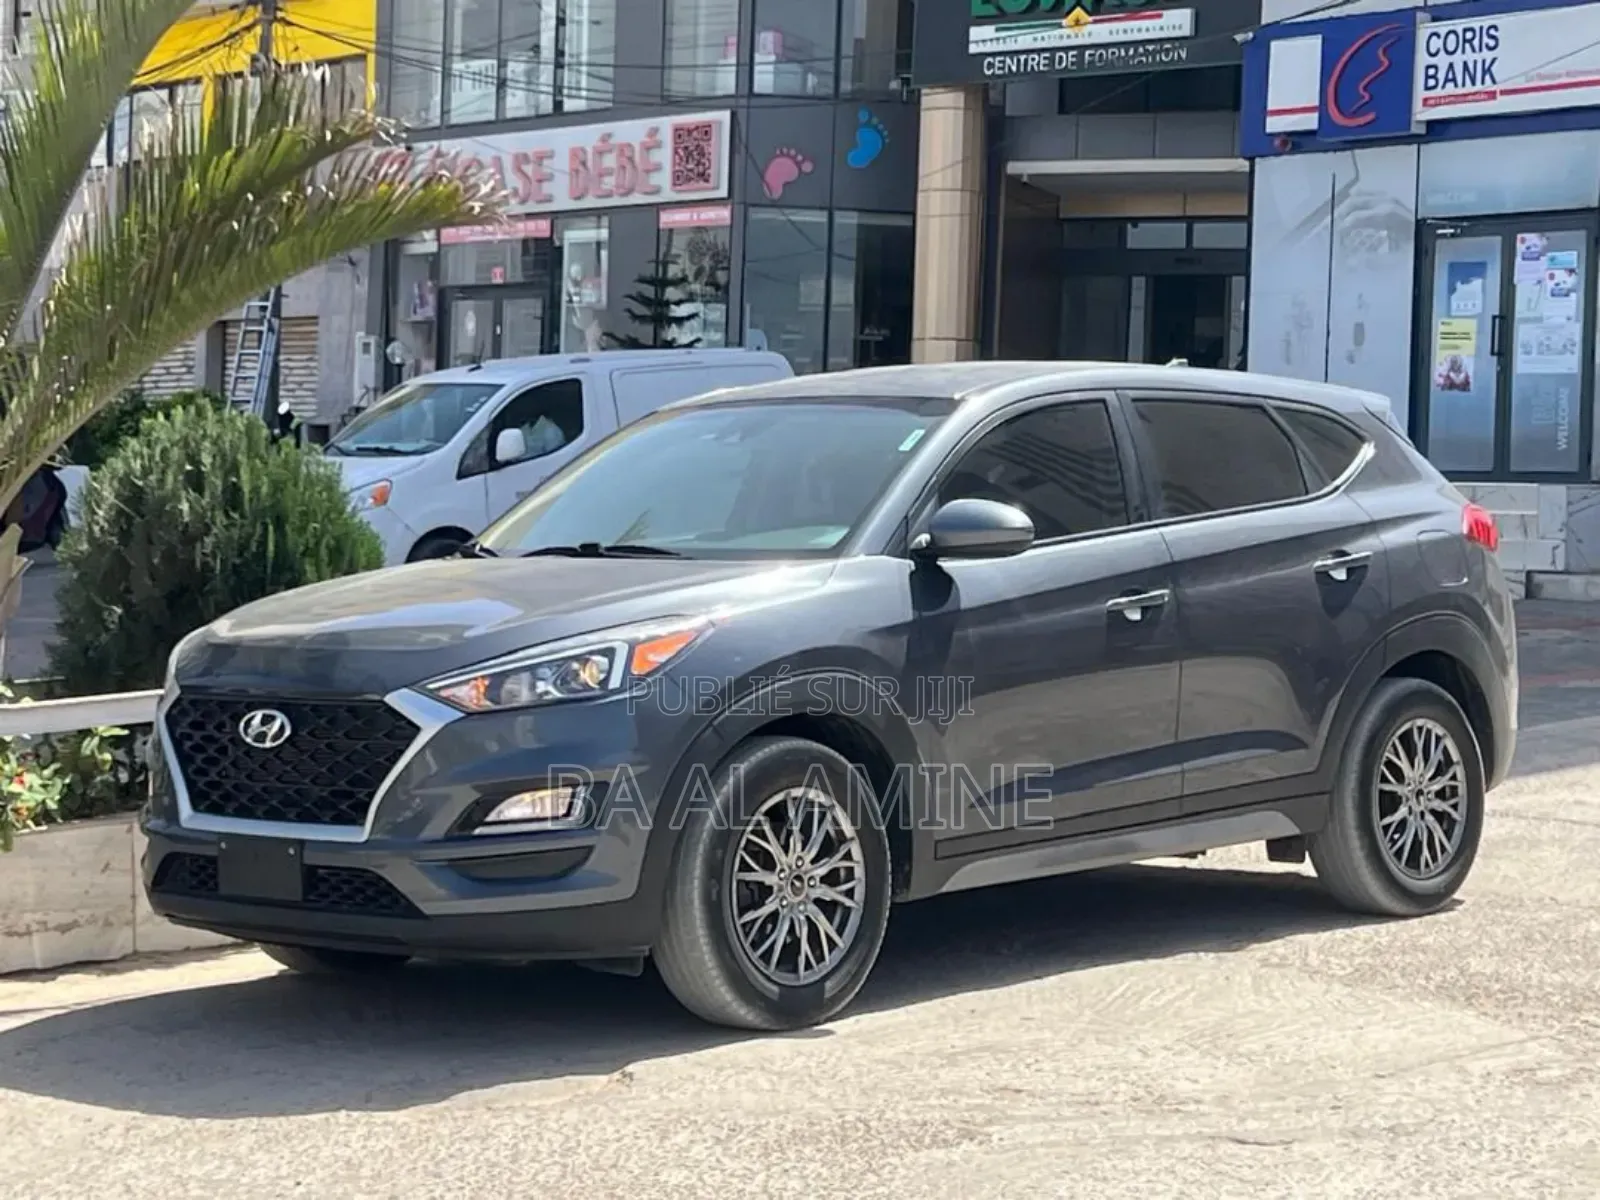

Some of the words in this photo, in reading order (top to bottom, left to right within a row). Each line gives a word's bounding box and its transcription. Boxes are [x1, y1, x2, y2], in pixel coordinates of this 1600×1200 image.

[1425, 24, 1500, 58] CORIS
[983, 53, 1050, 75] CENTRE
[1054, 51, 1078, 70] DE
[1084, 44, 1188, 68] FORMATION
[1423, 57, 1498, 91] BANK
[567, 126, 663, 200] BÉBÉ
[1556, 387, 1569, 450] WELCOME
